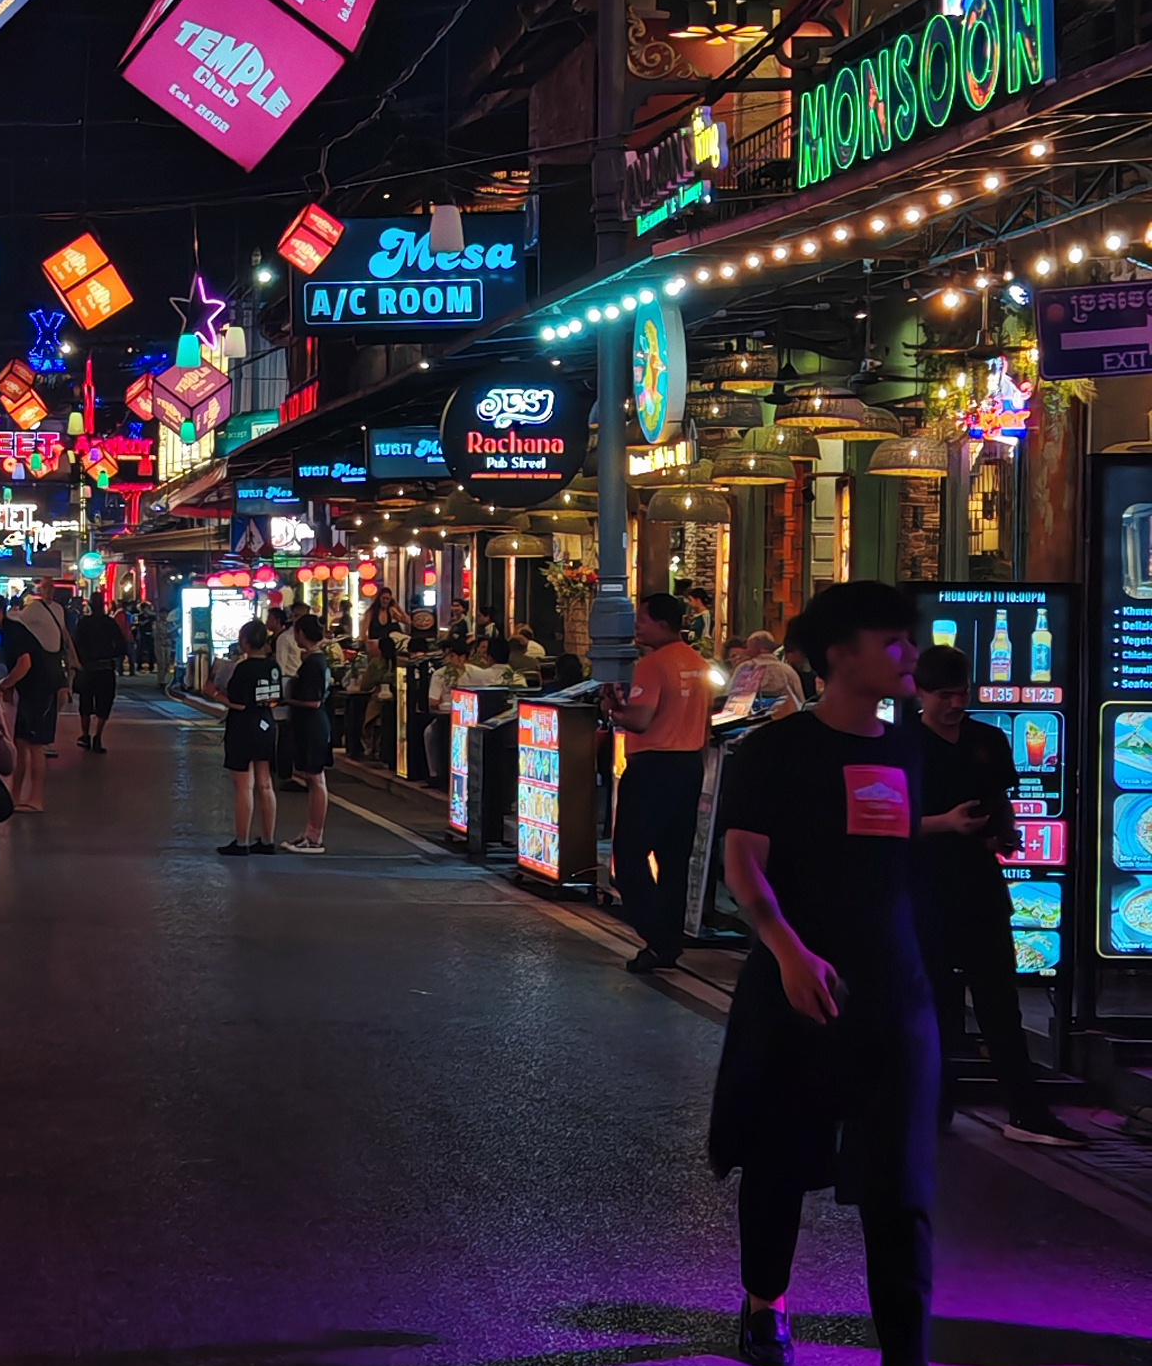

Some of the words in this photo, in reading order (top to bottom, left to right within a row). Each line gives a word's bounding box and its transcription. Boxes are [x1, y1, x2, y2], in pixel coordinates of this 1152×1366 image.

[174, 20, 291, 119] TEMPLE
[192, 65, 240, 108] Club
[168, 83, 194, 109] Est.
[195, 103, 230, 133] 2002
[368, 227, 516, 278] Mesa
[311, 288, 367, 321] A/C
[378, 286, 473, 315] ROOM
[1102, 350, 1148, 370] EXIT
[467, 429, 564, 454] Rachana
[331, 463, 367, 477] Mes
[486, 456, 508, 469] Pub
[511, 456, 546, 469] Street
[265, 486, 293, 499] Mes
[938, 591, 966, 602] FROM
[966, 591, 991, 603] OPEN
[993, 591, 1005, 603] TO
[1006, 591, 1046, 603] 10:00PM
[983, 688, 1013, 702] $1.35
[1025, 688, 1055, 702] $1.25
[1020, 804, 1034, 813] 1+1
